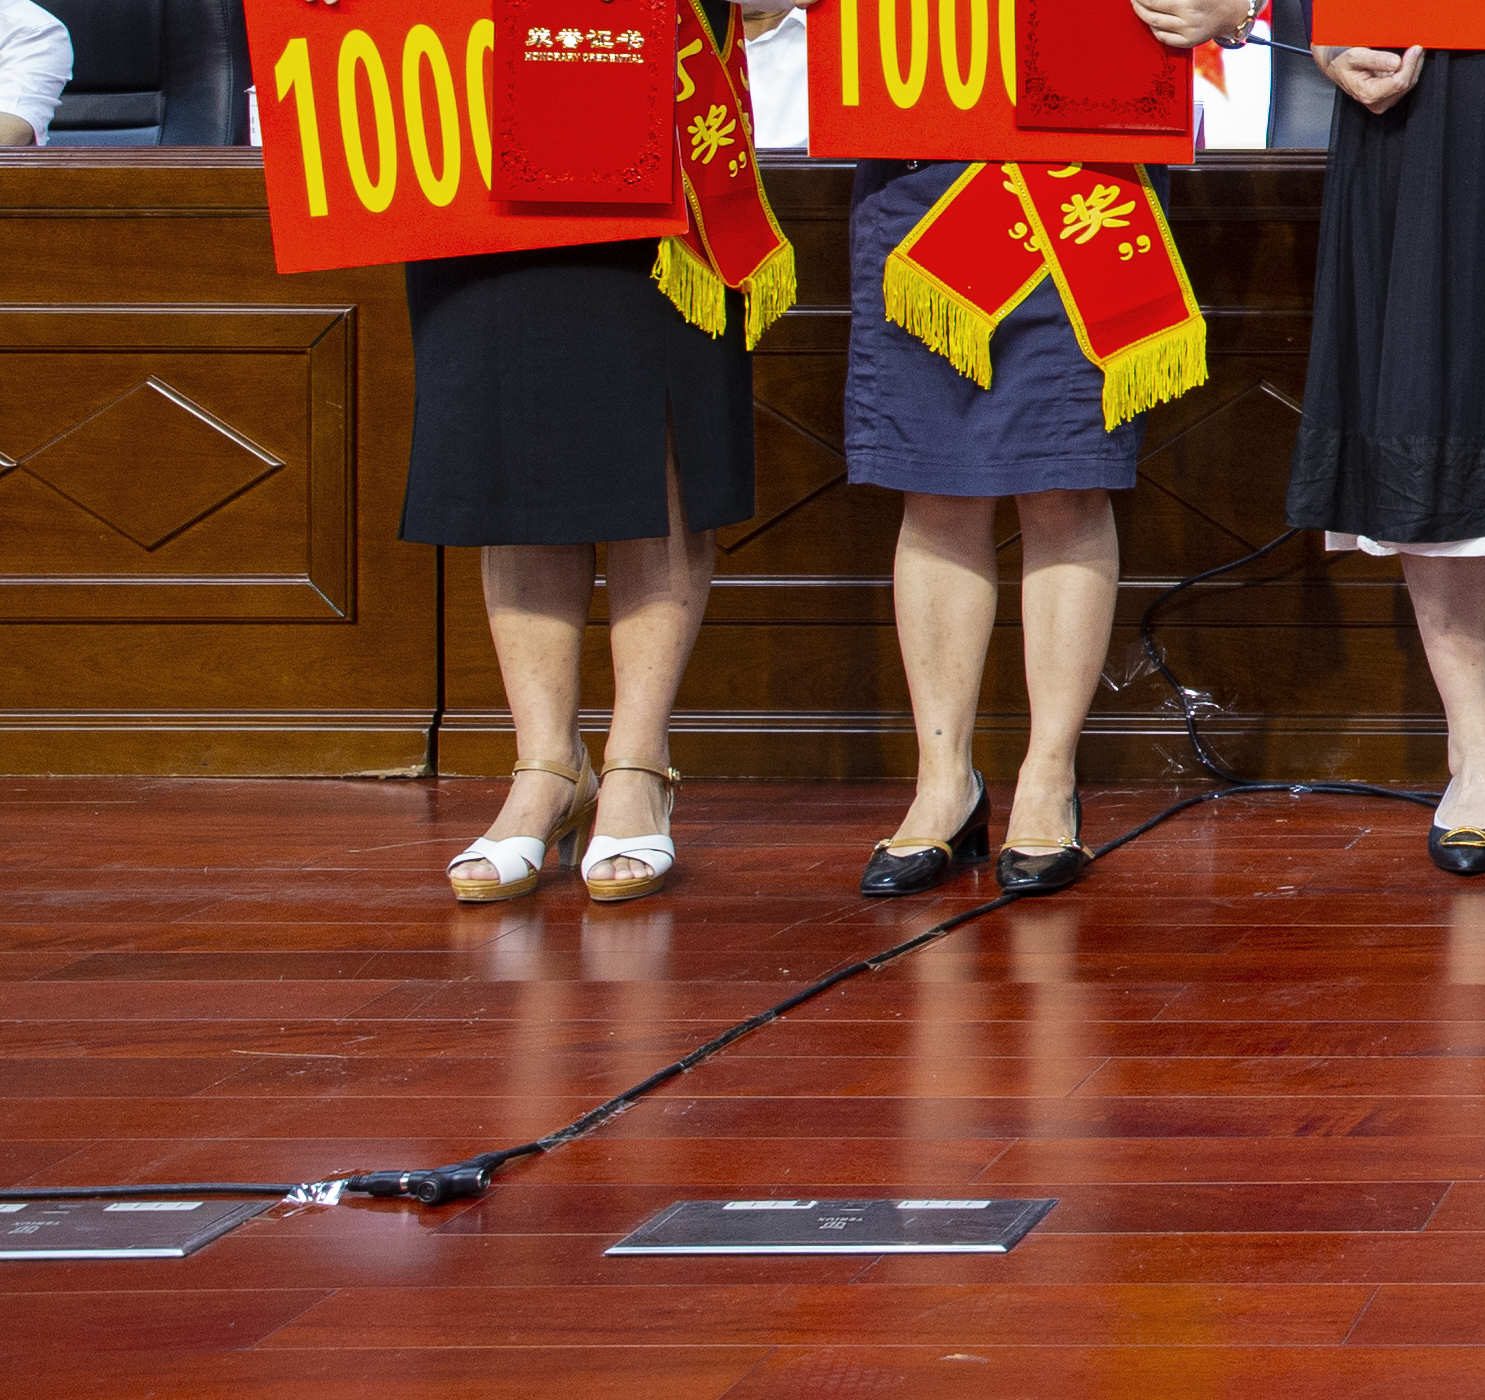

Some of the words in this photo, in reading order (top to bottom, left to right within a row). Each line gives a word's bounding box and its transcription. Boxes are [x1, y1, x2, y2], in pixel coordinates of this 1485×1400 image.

[525, 27, 645, 50] 荣誉证书
[525, 52, 581, 62] HONORARY
